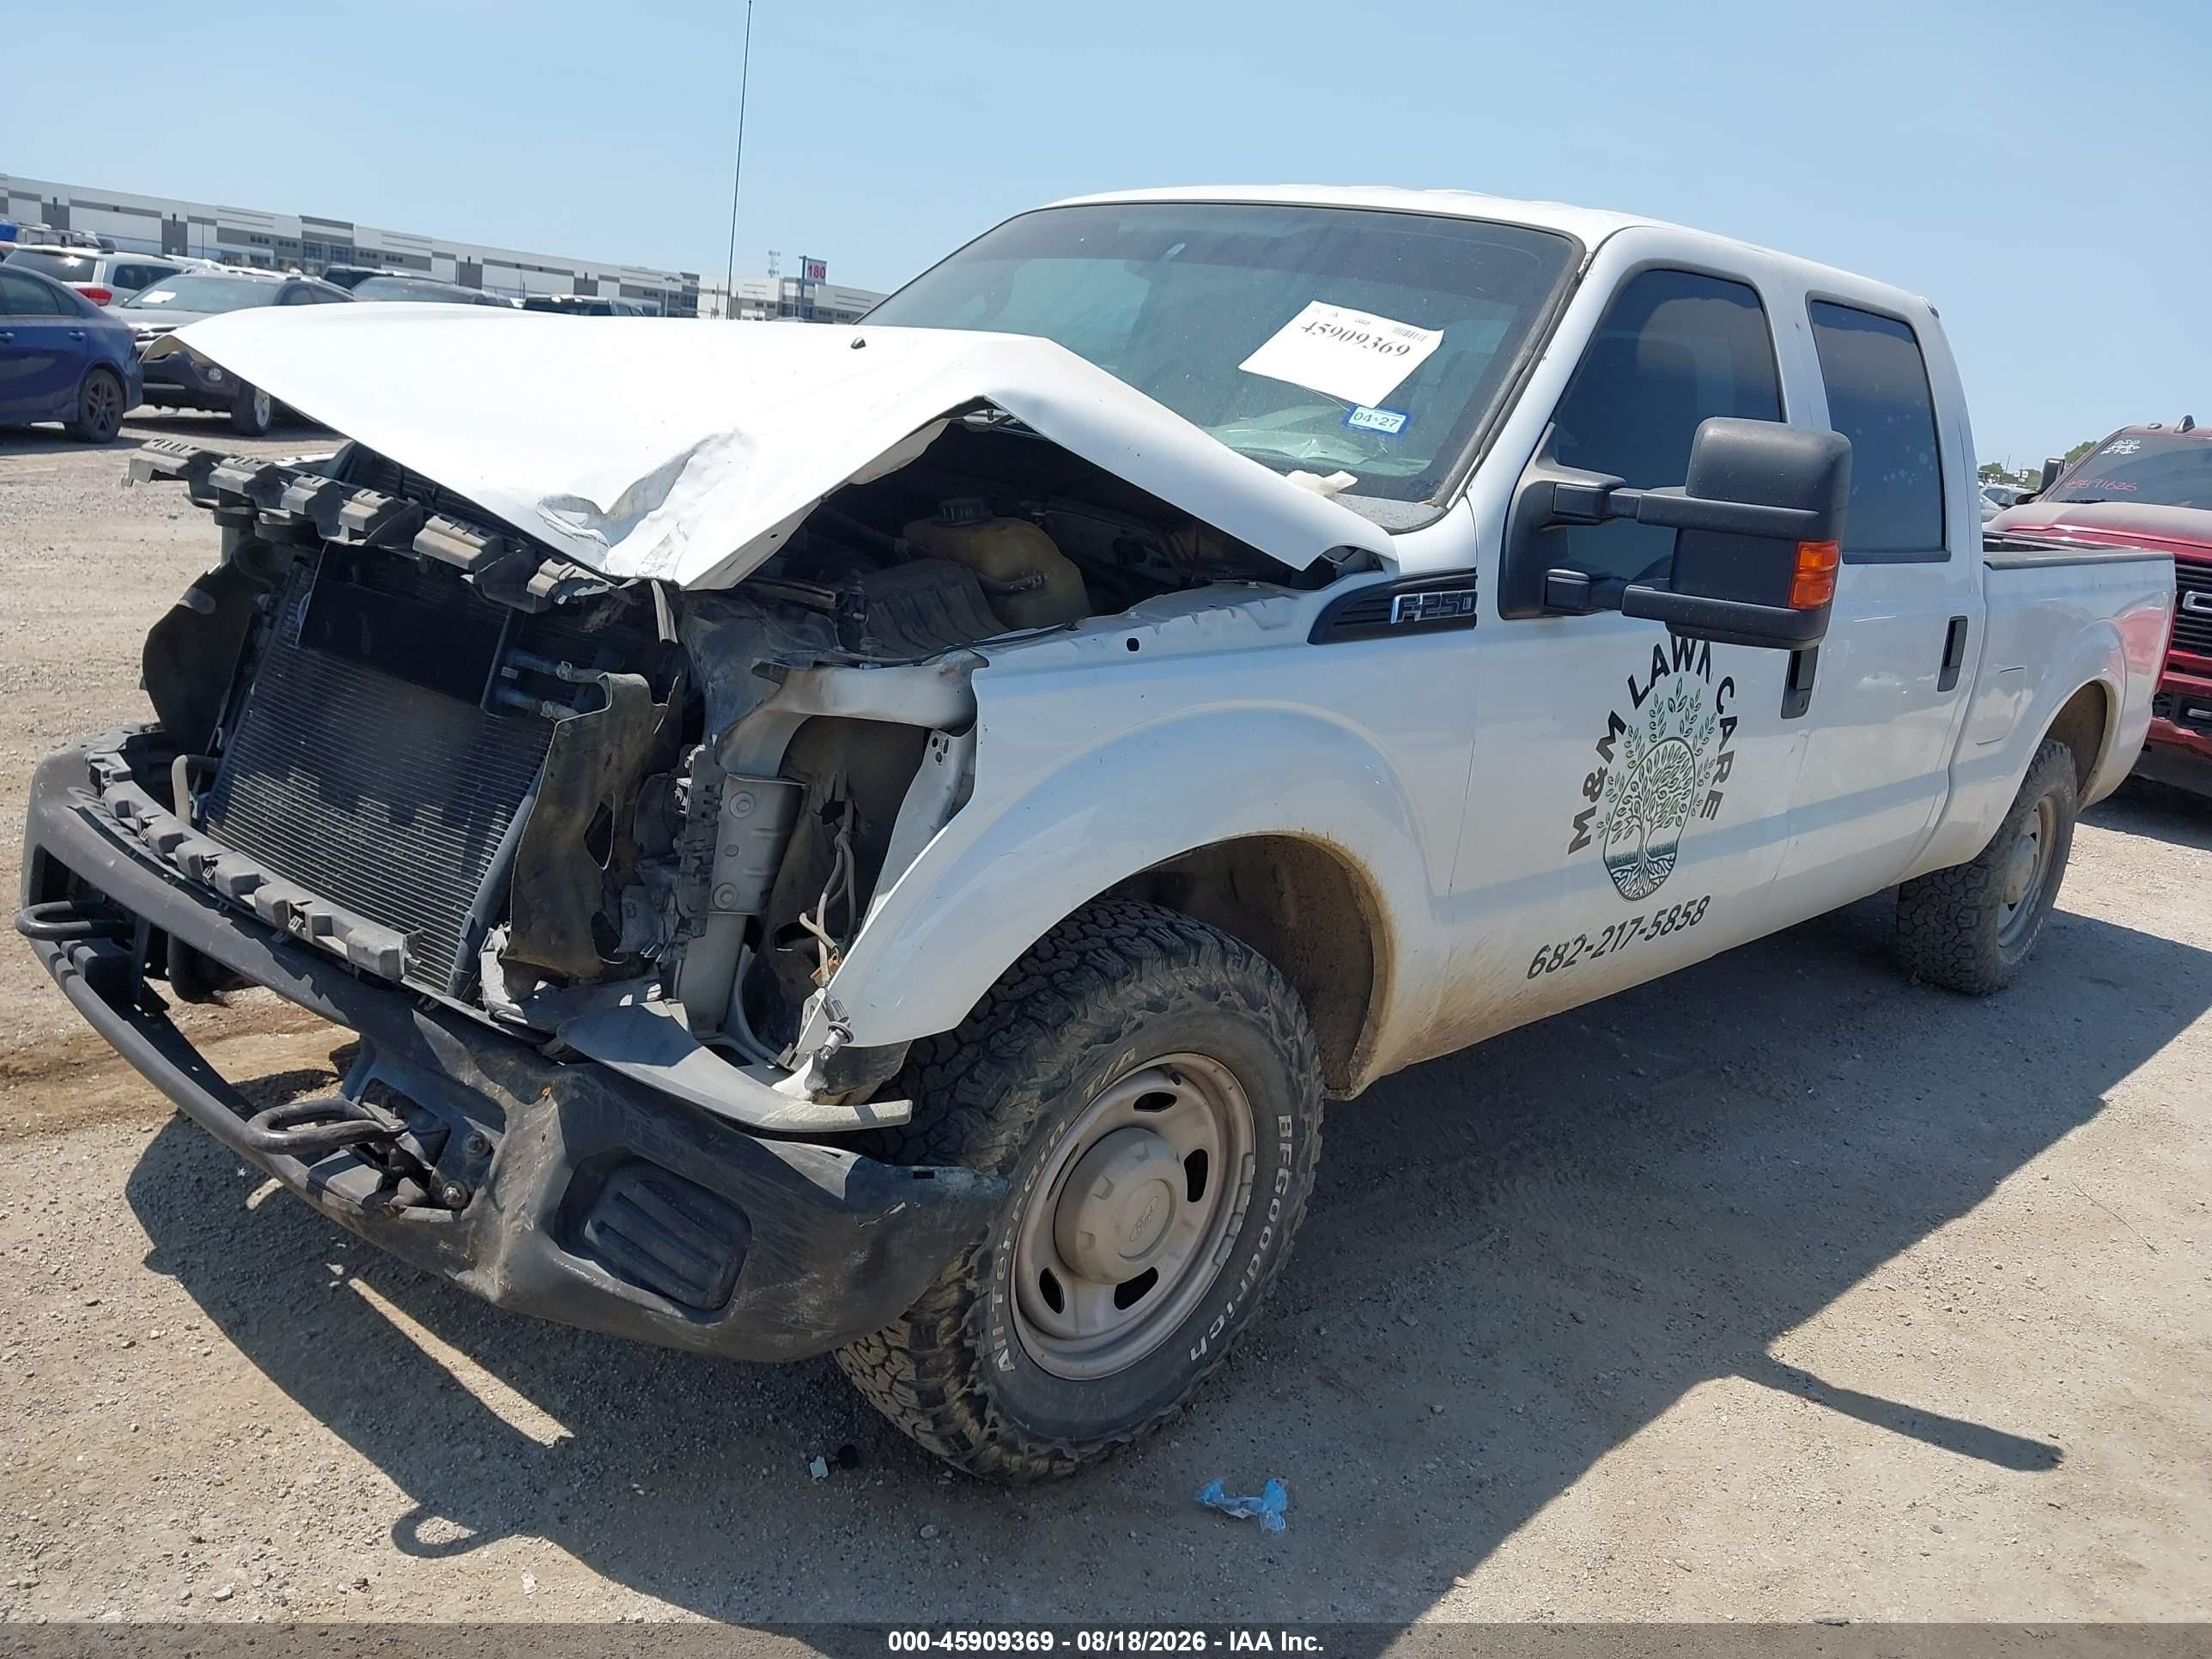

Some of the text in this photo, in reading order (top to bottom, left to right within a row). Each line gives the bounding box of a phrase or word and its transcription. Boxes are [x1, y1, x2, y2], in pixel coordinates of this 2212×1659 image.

[808, 264, 826, 279] 180
[1301, 320, 1411, 357] 45909369
[1568, 710, 1627, 854] M&M
[1700, 676, 1737, 821] CARE
[1527, 895, 1711, 980] 682-217-5858
[1189, 1115, 1291, 1362] BFGoodrich
